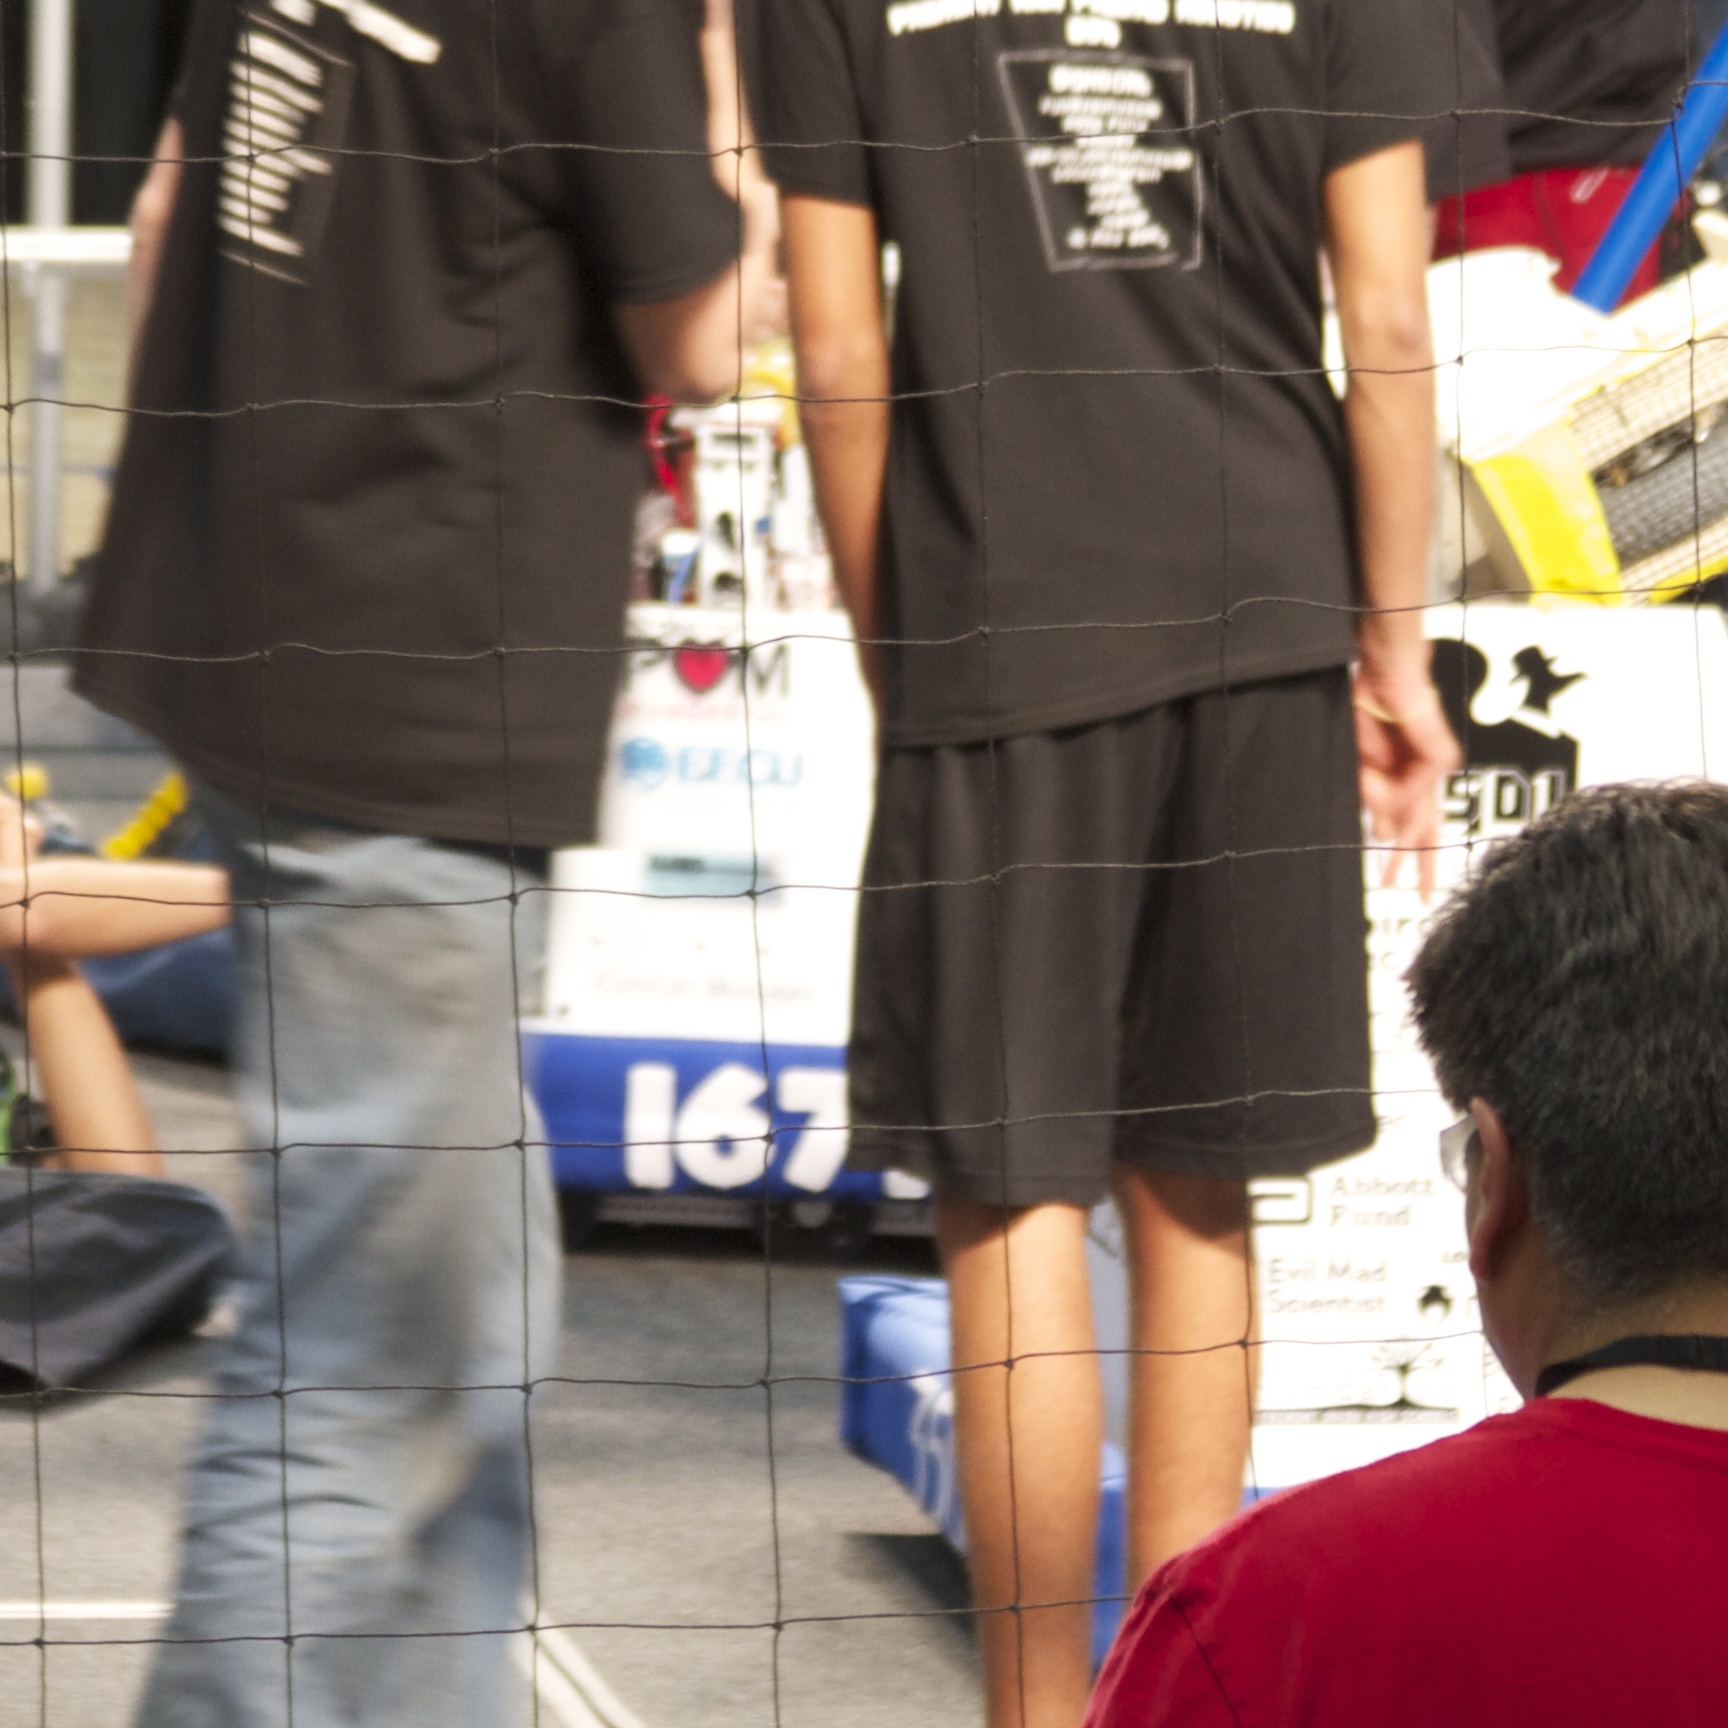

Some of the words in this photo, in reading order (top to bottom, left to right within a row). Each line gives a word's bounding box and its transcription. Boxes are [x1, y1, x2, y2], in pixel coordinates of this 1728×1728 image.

[626, 1062, 929, 1199] 167
[1332, 1177, 1434, 1197] Abbott
[1330, 1204, 1411, 1226] Fund
[1270, 1258, 1316, 1283] Evil
[1328, 1260, 1387, 1282] Mad
[1267, 1289, 1386, 1312] Scientist
